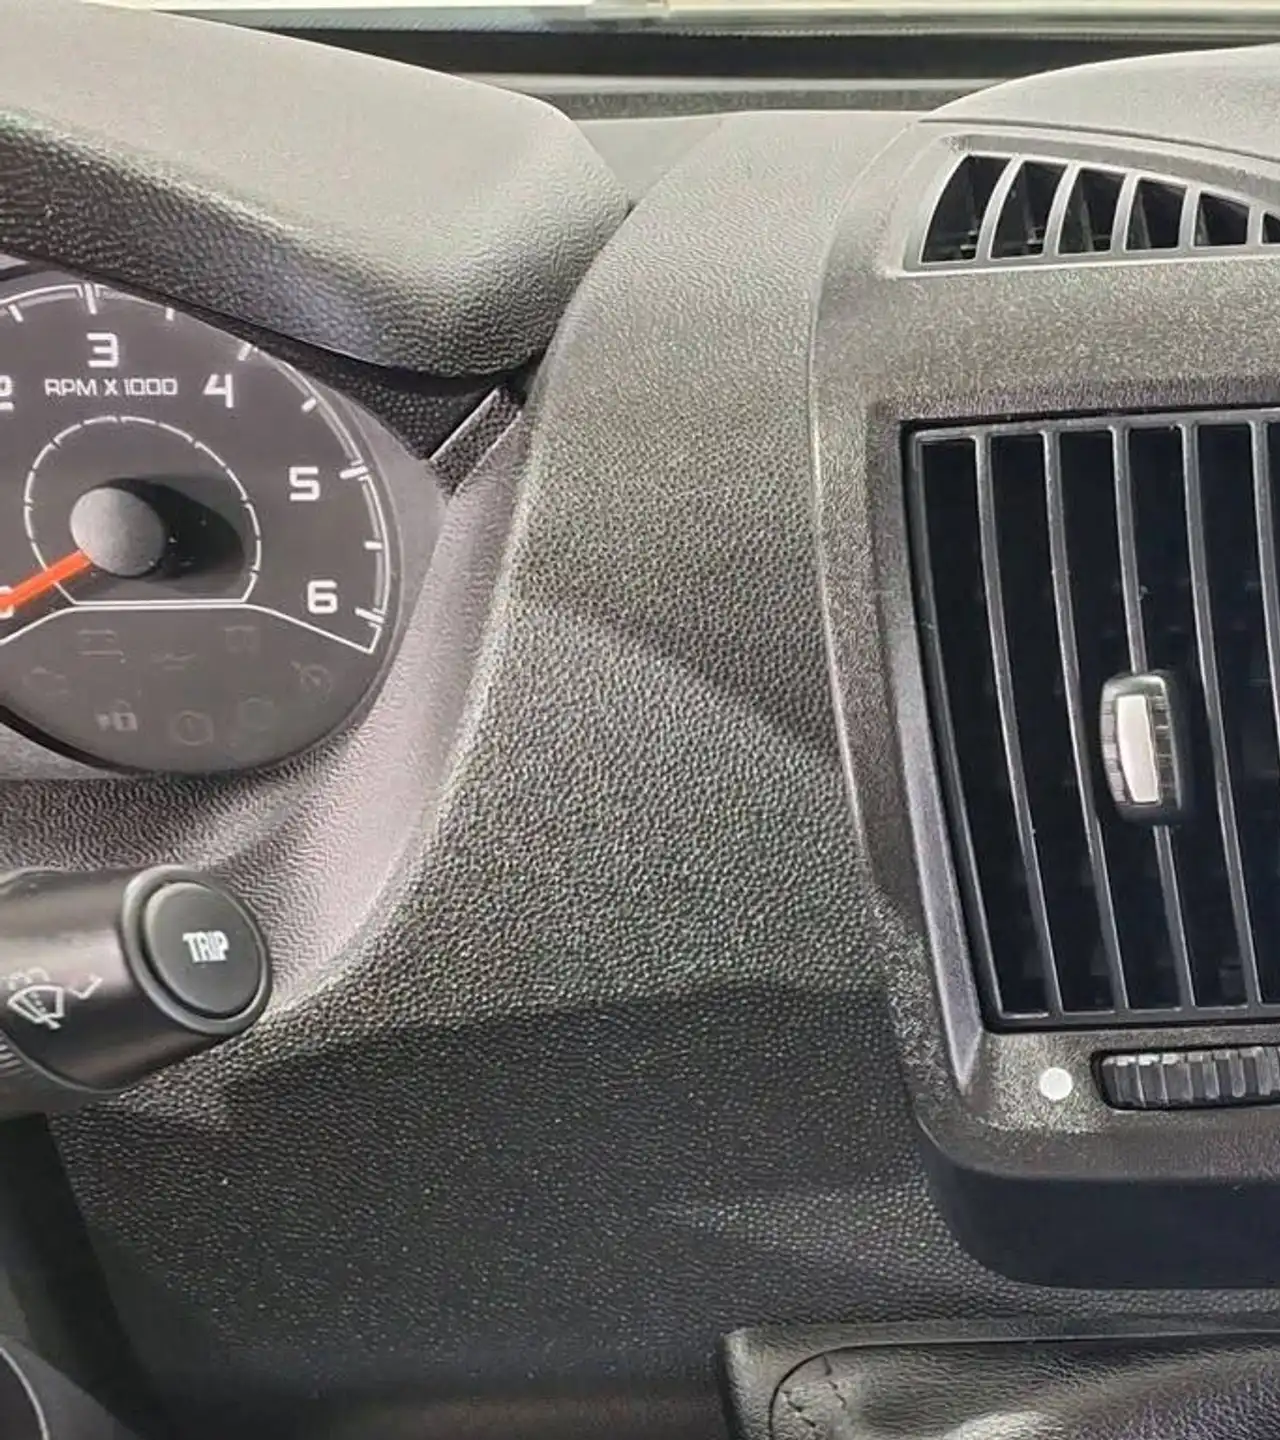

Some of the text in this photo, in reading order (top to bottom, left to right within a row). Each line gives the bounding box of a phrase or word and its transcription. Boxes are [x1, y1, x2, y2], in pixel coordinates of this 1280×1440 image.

[86, 332, 120, 368] 3
[44, 377, 179, 397] RPM X 1000
[203, 373, 234, 409] 4
[289, 466, 321, 501] 5
[307, 580, 338, 614] 6
[182, 930, 229, 963] TRIP
